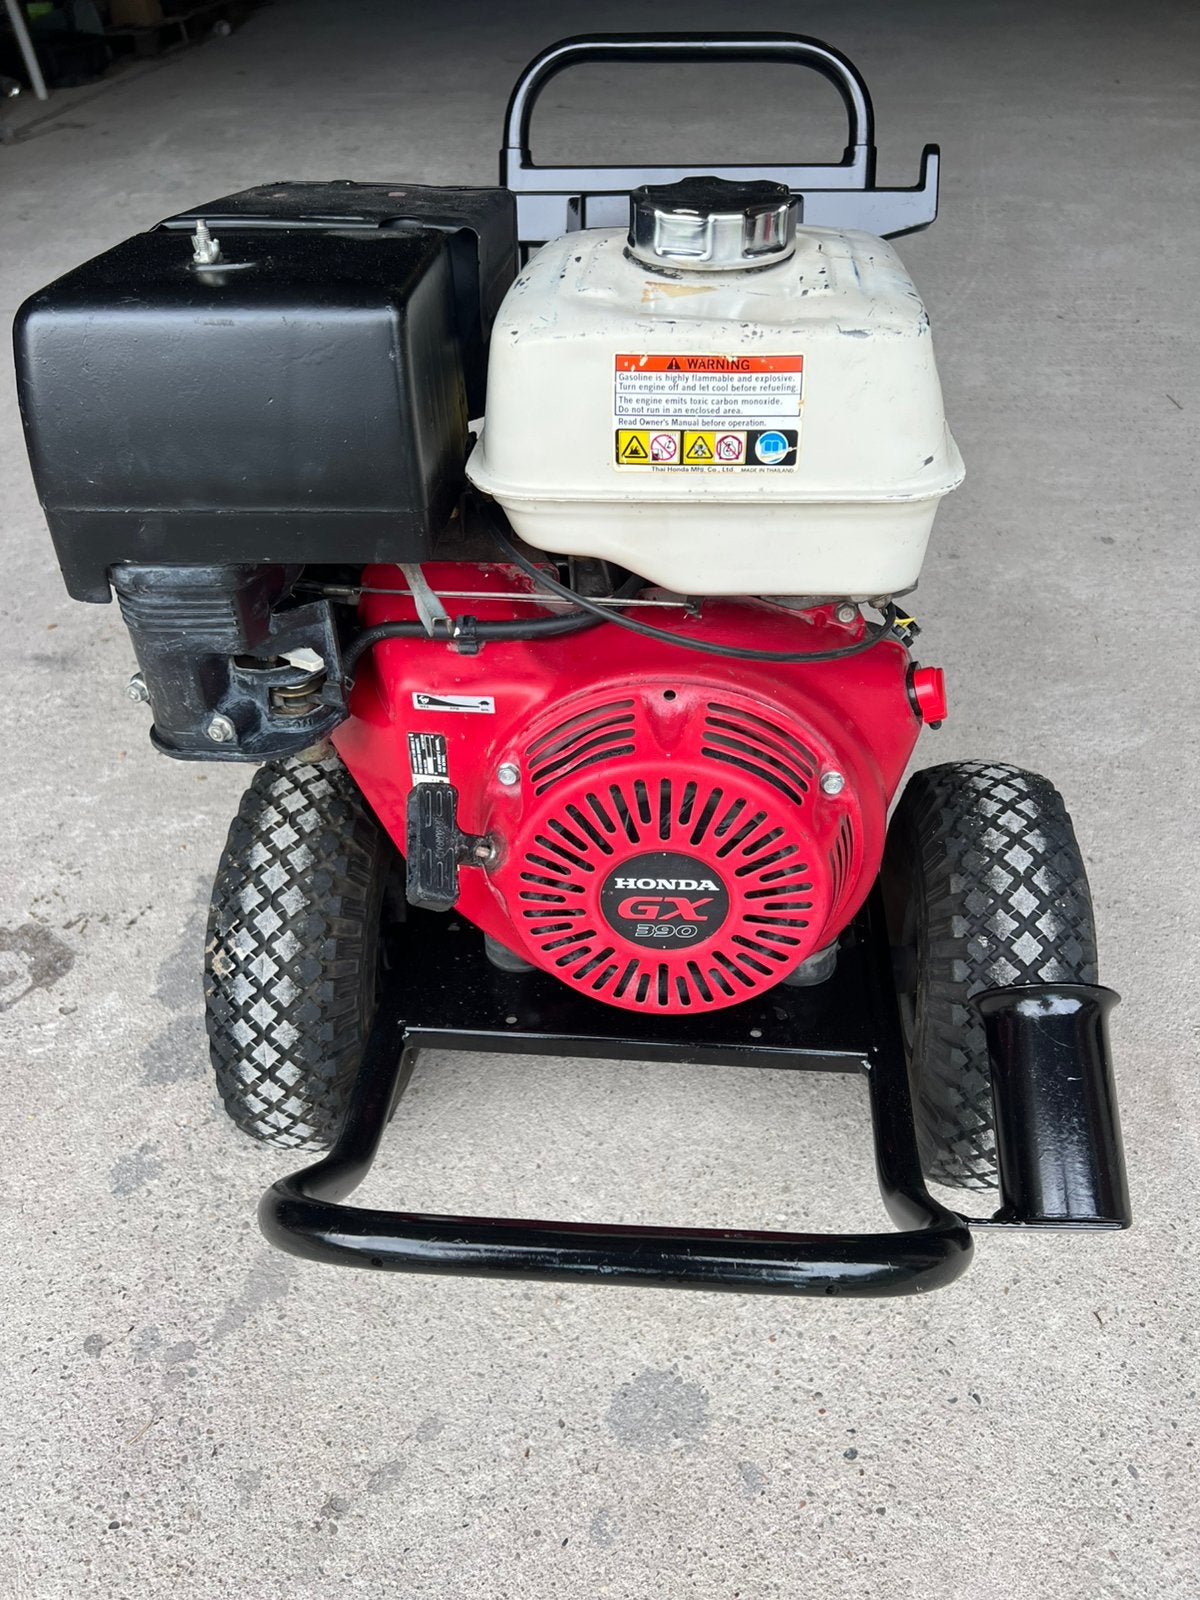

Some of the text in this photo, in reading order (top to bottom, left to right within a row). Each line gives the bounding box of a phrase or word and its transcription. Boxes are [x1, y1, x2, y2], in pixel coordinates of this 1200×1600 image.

[688, 358, 750, 370] WARNING
[665, 374, 689, 384] highly
[755, 376, 795, 384] explosive.
[638, 384, 666, 393] engine
[760, 385, 798, 393] refueling.
[636, 397, 663, 406] engine
[728, 420, 766, 428] operation.
[614, 878, 720, 891] HONDA
[617, 896, 715, 921] GX
[635, 924, 698, 938] 390
